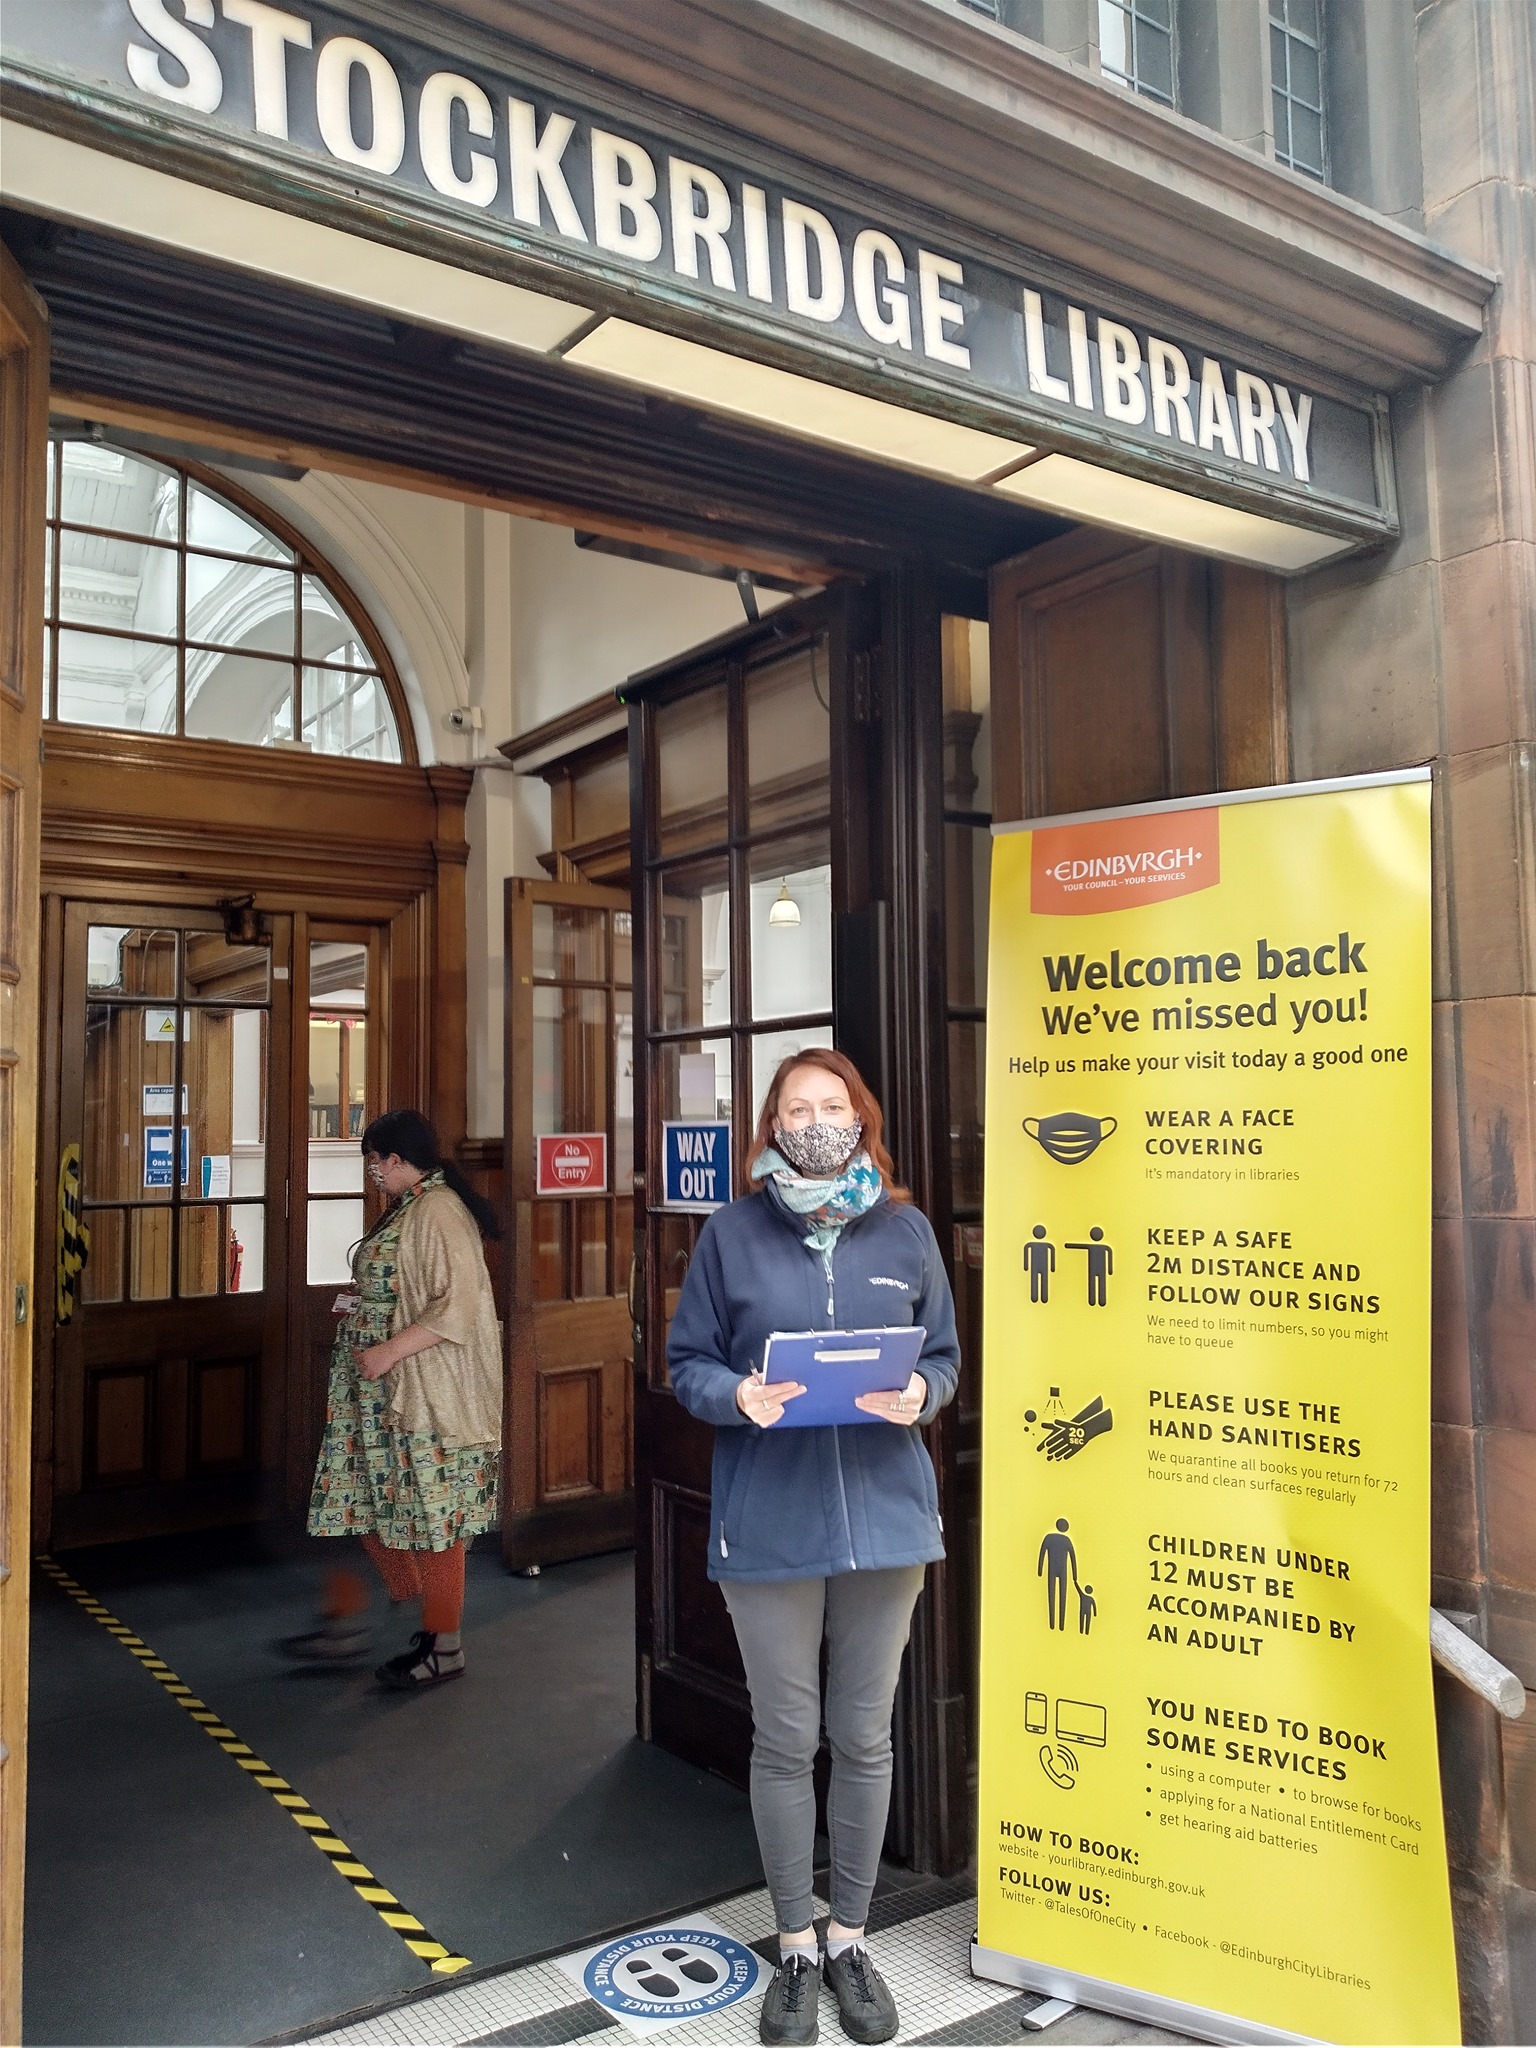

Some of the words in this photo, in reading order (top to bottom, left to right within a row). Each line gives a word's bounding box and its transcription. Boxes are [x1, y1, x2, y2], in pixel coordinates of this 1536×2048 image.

[124, 0, 970, 370] STOCKBRIDGE
[1023, 287, 1313, 484] LIBRARY
[1063, 883, 1084, 891] YOUR
[1085, 880, 1118, 889] COUNCIL
[1124, 876, 1146, 885] YOUR
[1148, 872, 1186, 883] SERVICES
[1043, 950, 1241, 992] Welcome
[1257, 932, 1368, 980] back
[1153, 993, 1277, 1030] missed
[1289, 988, 1367, 1034] you!
[1010, 1056, 1049, 1077] Help
[1056, 1060, 1076, 1072] us
[1083, 1054, 1130, 1072] make
[1136, 1057, 1179, 1075] your
[1184, 1050, 1226, 1069] visit
[1232, 1049, 1287, 1072] today
[1295, 1052, 1305, 1066] a
[1313, 1044, 1363, 1070] good
[1371, 1048, 1408, 1063] one
[1145, 1111, 1211, 1127] WEAR
[1219, 1110, 1234, 1126] A
[1243, 1109, 1294, 1126] FACE
[565, 1144, 579, 1156] No
[676, 1131, 716, 1163] WAY
[1146, 1139, 1262, 1155] COVERING
[558, 1167, 586, 1181] Entry
[680, 1167, 716, 1199] OUT
[1166, 1168, 1231, 1182] mandatory
[1235, 1169, 1245, 1179] in
[1250, 1169, 1299, 1180] libraries
[1148, 1228, 1205, 1246] KEEP
[1213, 1231, 1228, 1247] A
[1236, 1231, 1292, 1249] SAFE
[1147, 1253, 1181, 1274] 2M
[1192, 1258, 1304, 1279] DISTANCE
[1313, 1263, 1360, 1281] AND
[1149, 1285, 1240, 1305] FOLLOW
[1250, 1290, 1299, 1308] OUR
[1308, 1292, 1380, 1314] SIGNS
[1147, 1315, 1165, 1326] We
[1170, 1317, 1198, 1328] need
[1203, 1319, 1214, 1329] to
[1219, 1318, 1246, 1331] limit
[1250, 1322, 1307, 1336] numbers,
[1312, 1327, 1325, 1336] so
[1329, 1328, 1350, 1340] you
[1355, 1328, 1389, 1343] might
[1148, 1332, 1175, 1345] have
[1179, 1335, 1191, 1346] to
[1195, 1338, 1233, 1349] queue
[1150, 1390, 1234, 1413] PLEASE
[1245, 1398, 1290, 1418] USE
[1299, 1402, 1340, 1424] THE
[1068, 1427, 1085, 1438] 20
[1150, 1419, 1212, 1440] HAND
[1222, 1425, 1360, 1457] SANITISERS
[1148, 1450, 1166, 1462] We
[1170, 1454, 1237, 1469] quarantine
[1241, 1459, 1255, 1470] all
[1260, 1460, 1297, 1475] books
[1301, 1468, 1321, 1479] you
[1326, 1471, 1360, 1485] return
[1364, 1474, 1380, 1488] for
[1384, 1481, 1398, 1492] 72
[1148, 1467, 1182, 1482] hours
[1186, 1473, 1208, 1484] and
[1213, 1474, 1245, 1488] clean
[1250, 1479, 1302, 1495] surfaces
[1306, 1487, 1356, 1506] regularly
[1148, 1534, 1265, 1564] CHILDREN
[1277, 1549, 1350, 1581] UNDER
[1149, 1560, 1177, 1583] 12
[1187, 1569, 1256, 1593] MUST
[1266, 1578, 1294, 1599] BE
[1147, 1594, 1320, 1633] ACCOMPANIED
[1330, 1620, 1355, 1642] BY
[1147, 1624, 1177, 1644] AN
[1187, 1630, 1263, 1656] ADULT
[1146, 1697, 1194, 1721] YOU
[1206, 1707, 1268, 1733] NEED
[1277, 1719, 1308, 1740] TO
[1319, 1726, 1387, 1760] BOOK
[1147, 1728, 1215, 1757] SOME
[1225, 1742, 1346, 1780] SERVICES
[1161, 1765, 1194, 1782] using
[1198, 1772, 1205, 1782] a
[1209, 1772, 1272, 1795] computer
[1160, 1790, 1214, 1810] applying
[1218, 1797, 1235, 1812] for
[1239, 1805, 1246, 1814] a
[1251, 1804, 1305, 1826] National
[1311, 1816, 1387, 1845] Entitlement
[1391, 1836, 1419, 1855] Card
[1293, 1788, 1306, 1801] to
[1311, 1790, 1358, 1812] browse
[1363, 1802, 1380, 1817] for
[1384, 1807, 1421, 1831] books
[1001, 1821, 1042, 1842] HOW
[1049, 1831, 1072, 1849] TO
[1079, 1838, 1138, 1869] BOOK:
[1160, 1814, 1179, 1826] get
[1184, 1815, 1231, 1839] hearing
[1235, 1827, 1254, 1841] aid
[1259, 1830, 1318, 1854] batteries
[999, 1843, 1038, 1859] website
[1048, 1853, 1206, 1898] yourlibrary.edinburgh.gov.uk
[1000, 1866, 1071, 1900] FOLLOW
[1079, 1885, 1109, 1907] US:
[1001, 1887, 1035, 1905] Twitter
[1044, 1898, 1136, 1932] @TalesOfOneCity
[633, 1934, 675, 1950] YOUR
[680, 1934, 721, 1947] KEEP
[593, 1944, 632, 1987] DISTANCE
[732, 1959, 747, 1983] KEEP
[1155, 1925, 1209, 1949] Facebook
[1220, 1941, 1371, 1990] @EdinburghCityLibraries
[620, 1998, 703, 2014] DISTANCE
[704, 1980, 743, 2008] YOUR
